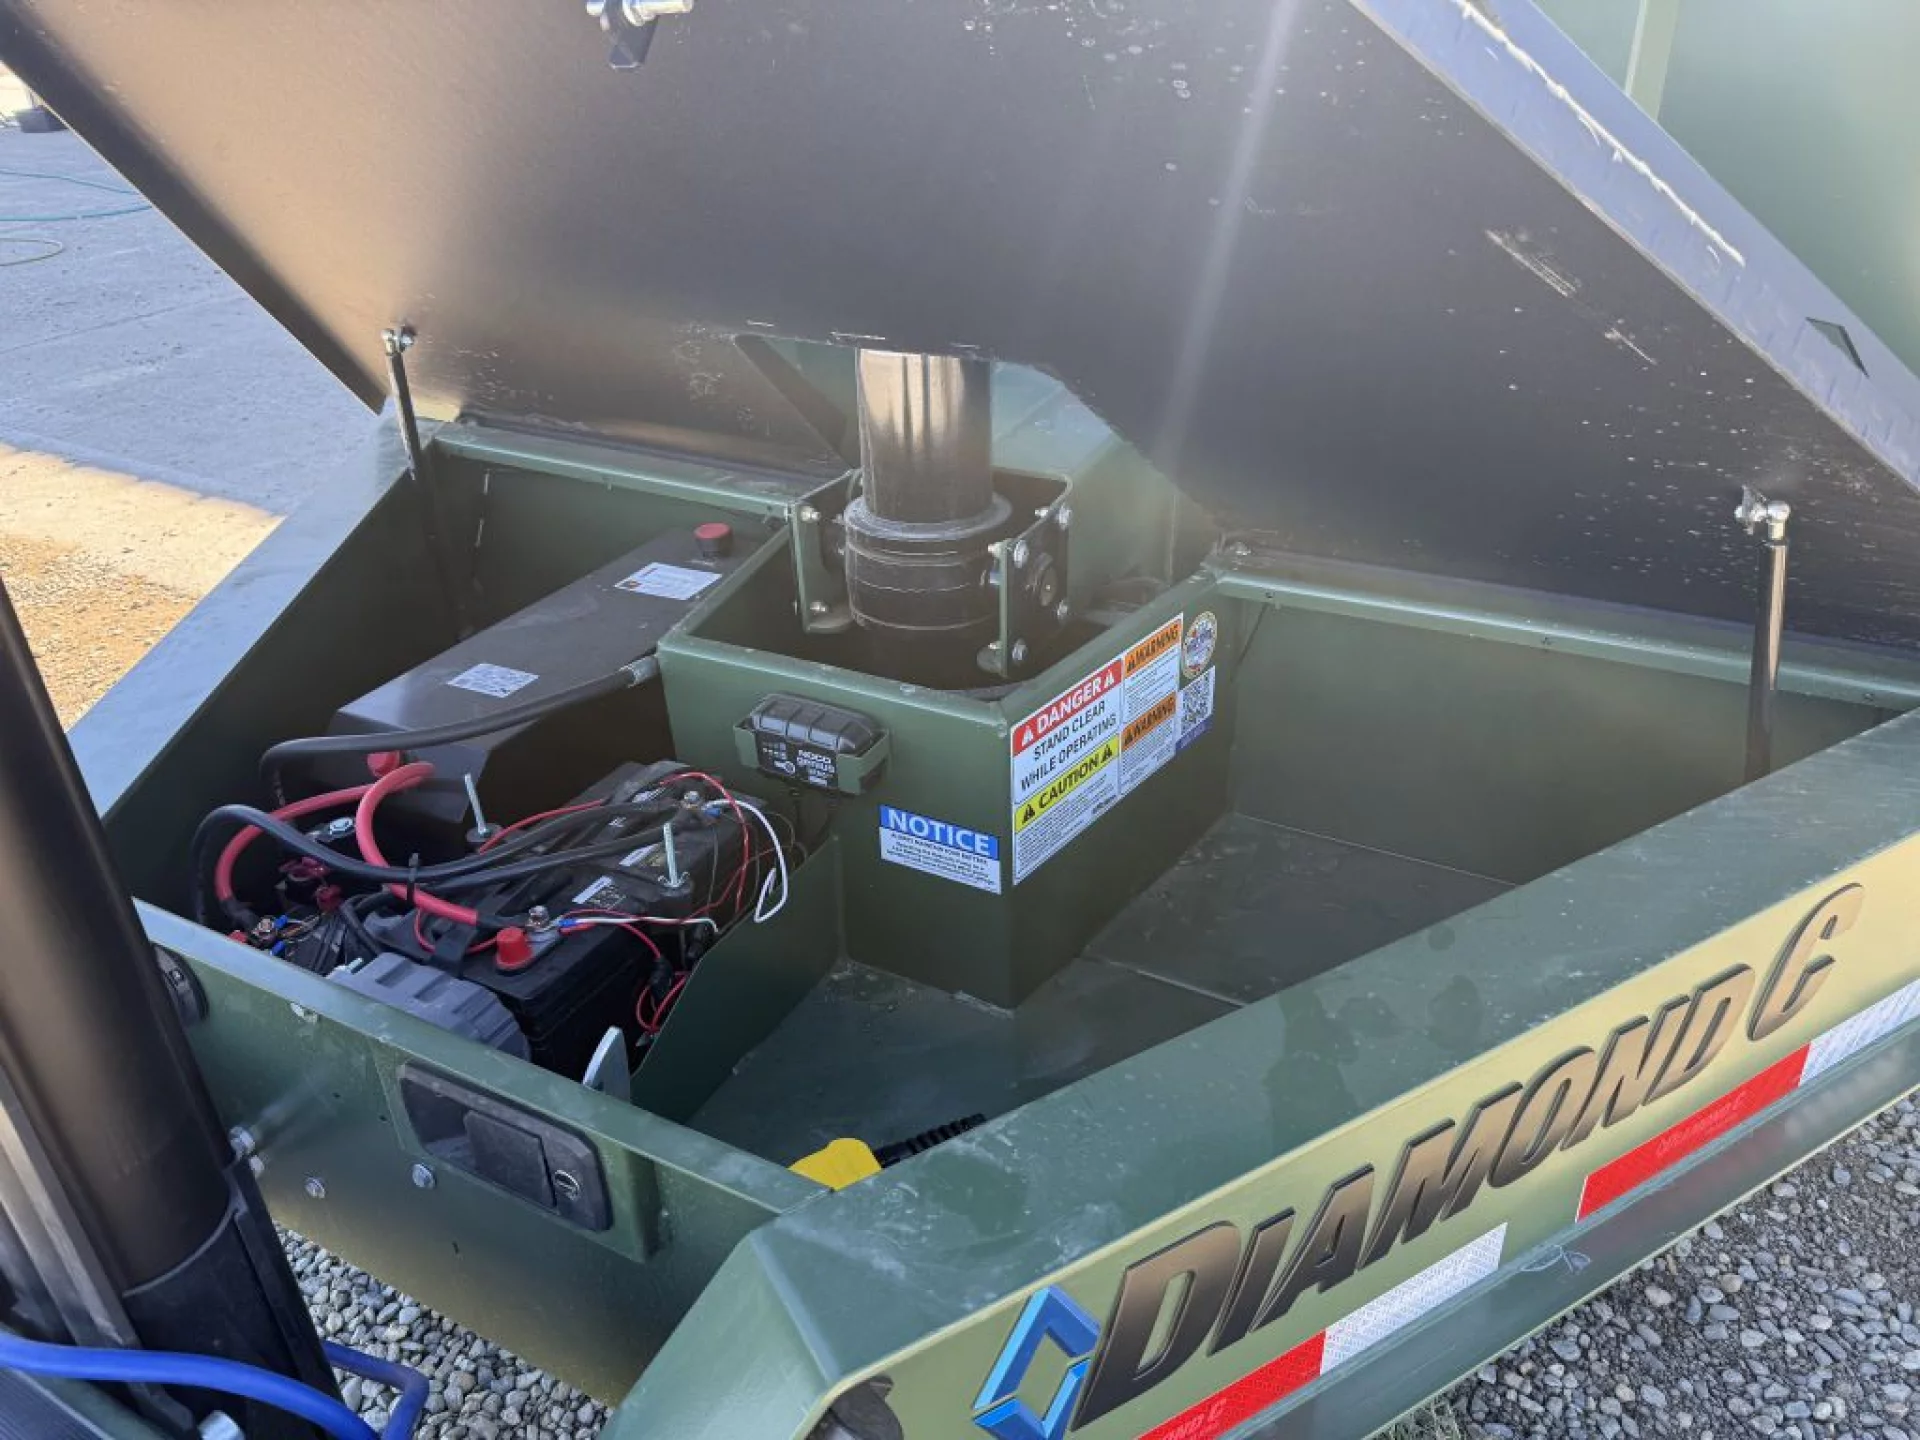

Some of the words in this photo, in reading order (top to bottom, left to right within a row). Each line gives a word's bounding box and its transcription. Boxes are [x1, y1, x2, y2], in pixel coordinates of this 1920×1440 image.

[1034, 726, 1069, 761] STAND
[1072, 701, 1105, 733] CLEAR
[1037, 677, 1102, 734] DANGER
[1021, 756, 1056, 791] WHILE
[1059, 713, 1116, 764] OPERATING
[1039, 752, 1100, 809] CAUTION
[888, 808, 991, 856] NOTICE
[1070, 963, 1756, 1432] DIAMOND
[1747, 882, 1866, 1042] C
